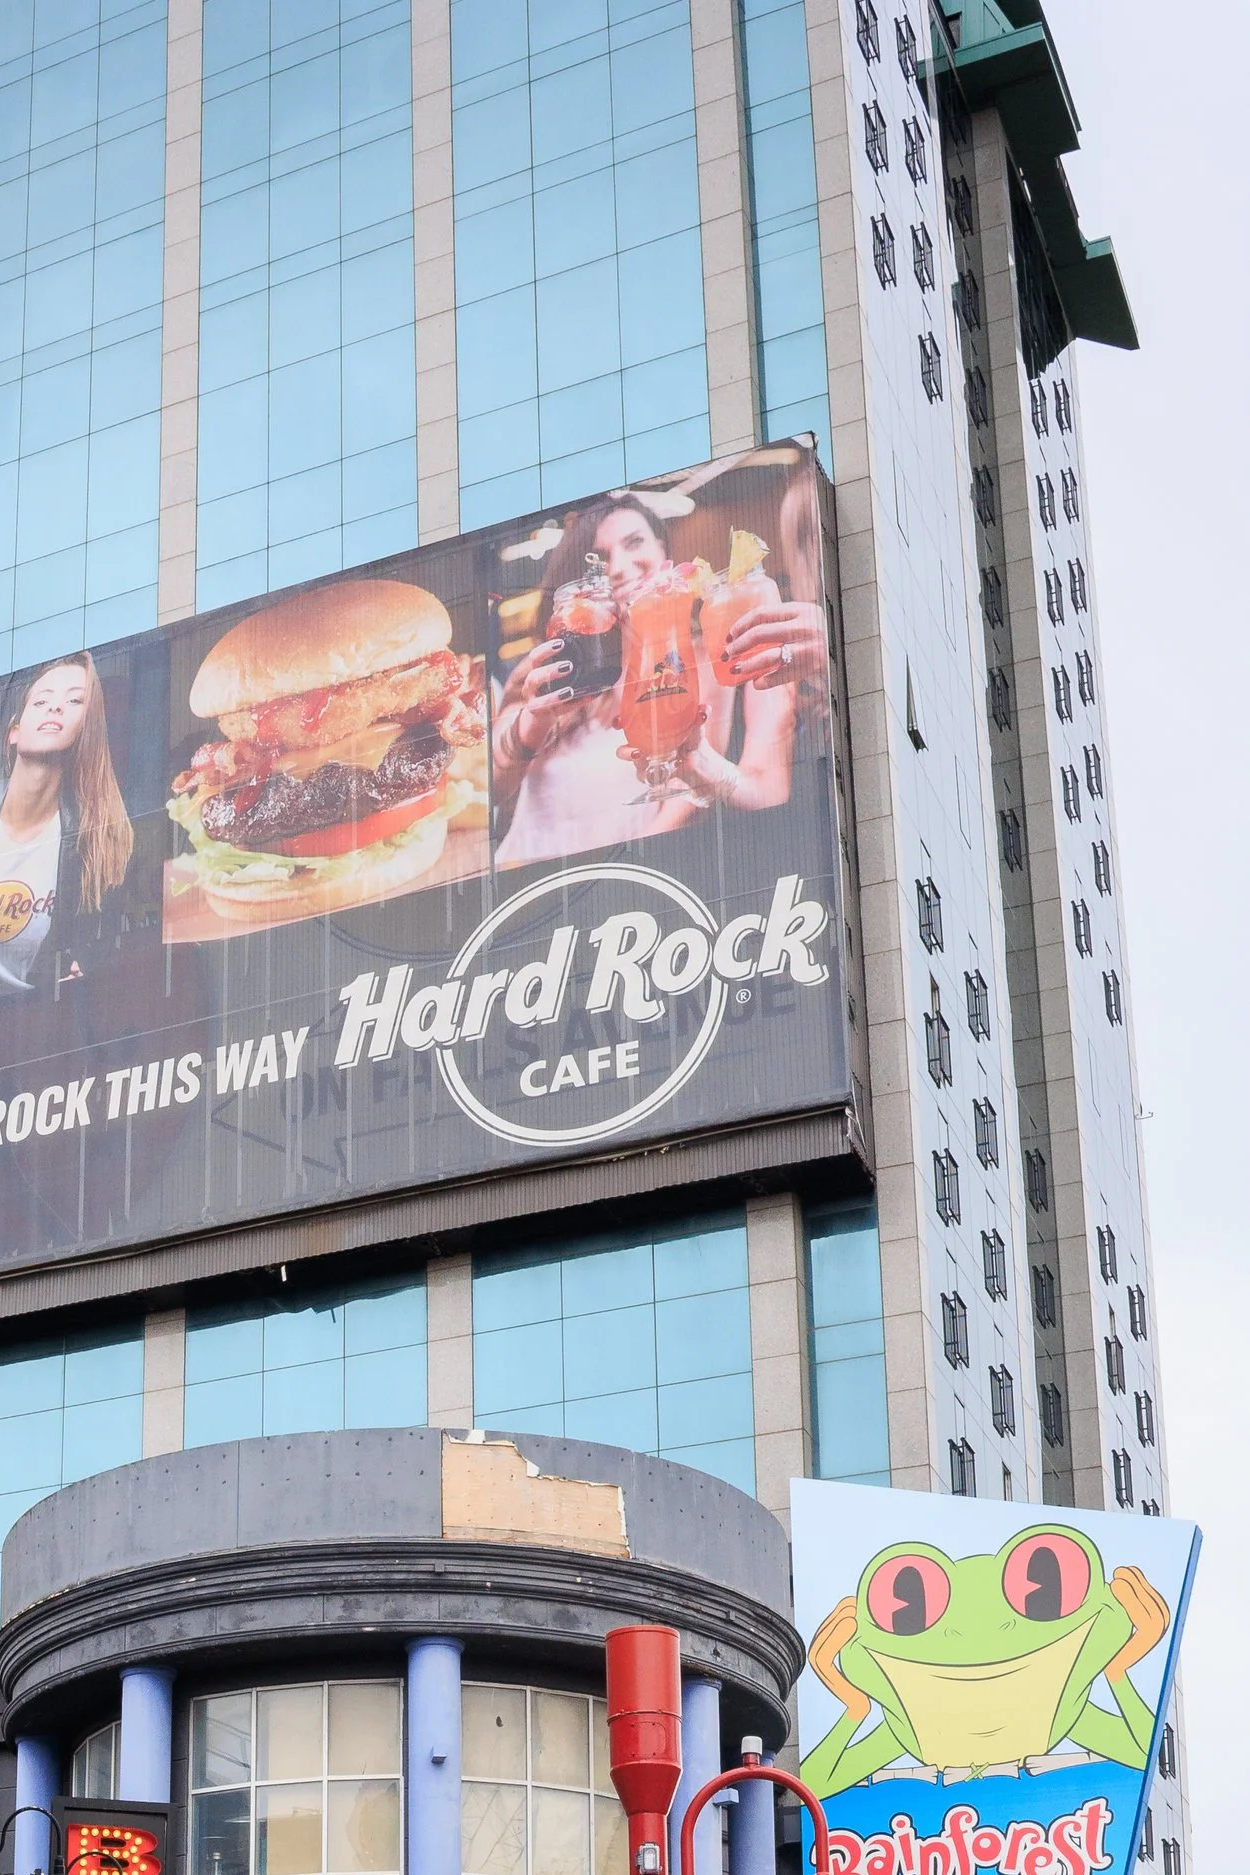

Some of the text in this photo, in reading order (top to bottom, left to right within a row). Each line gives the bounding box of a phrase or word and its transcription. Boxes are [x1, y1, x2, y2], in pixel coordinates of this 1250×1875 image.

[3, 889, 55, 919] Rock
[334, 873, 830, 1070] Hard Rock
[105, 1052, 202, 1120] THIS
[215, 1026, 310, 1094] WAY
[519, 1040, 640, 1098] CAFE
